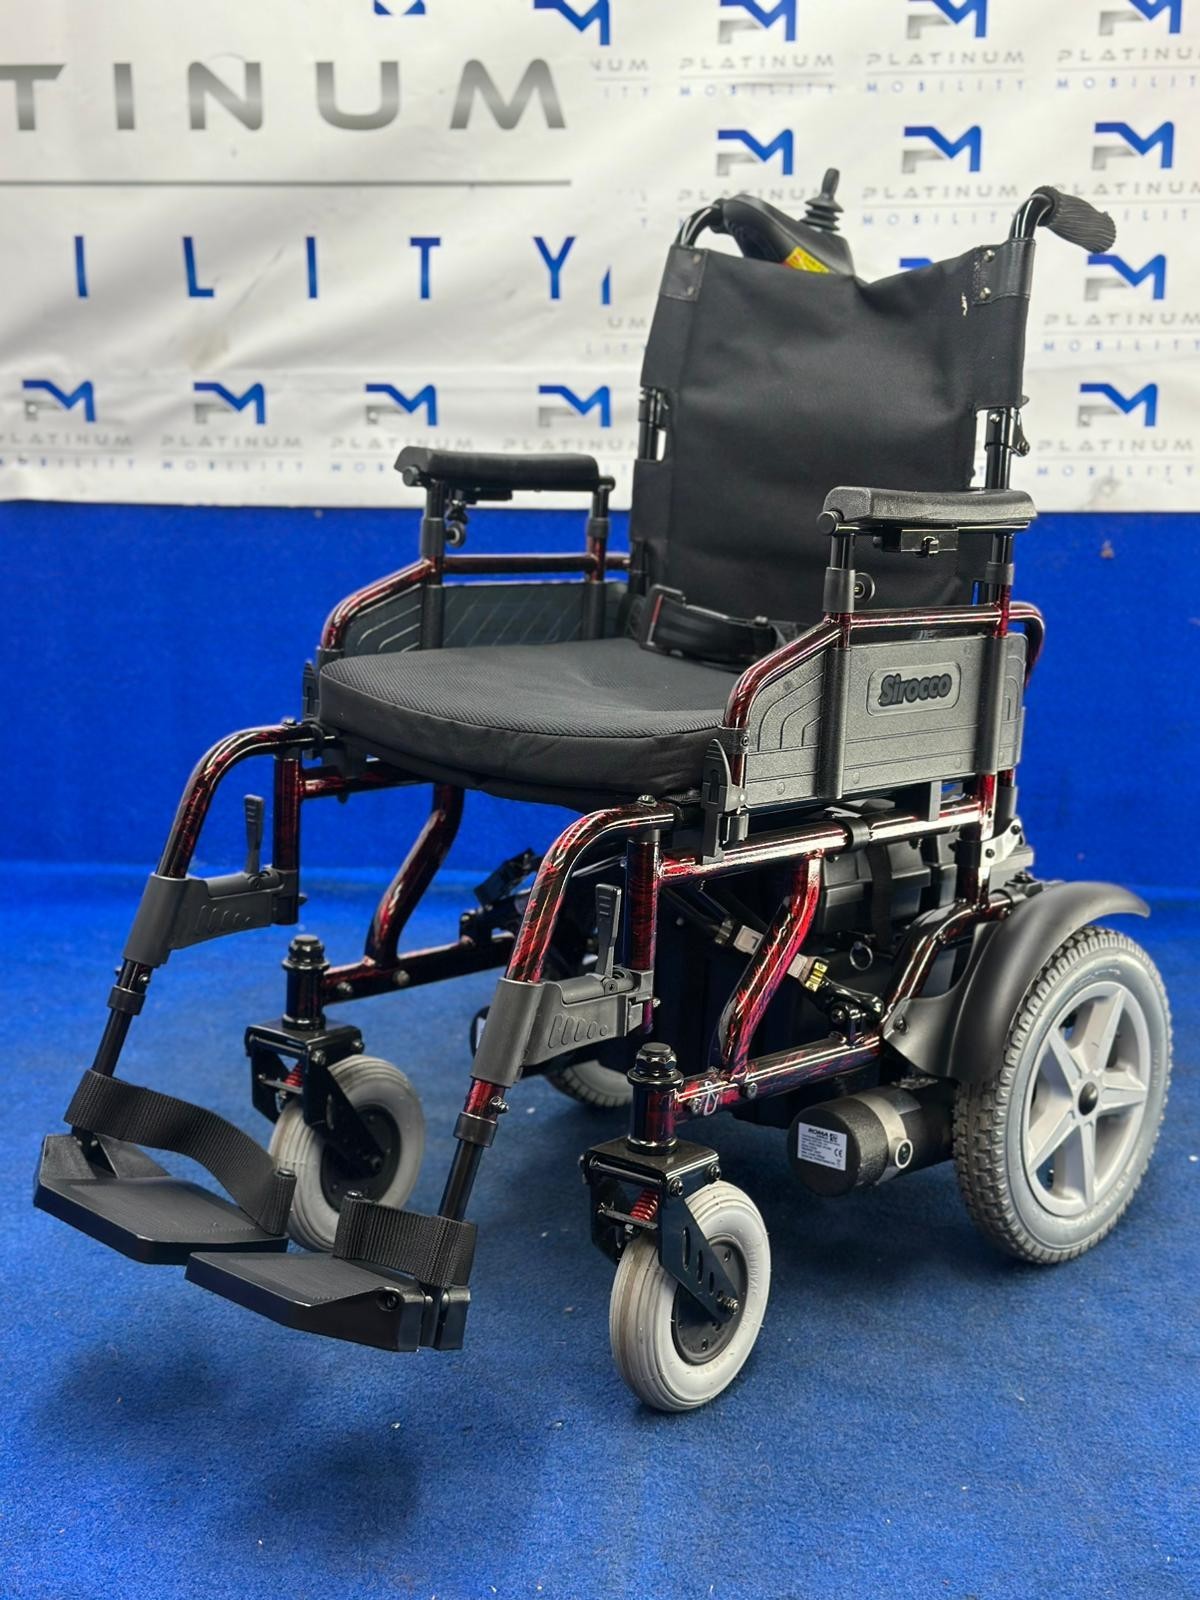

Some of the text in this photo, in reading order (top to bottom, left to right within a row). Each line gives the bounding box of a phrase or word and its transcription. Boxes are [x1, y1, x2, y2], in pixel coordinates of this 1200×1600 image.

[680, 54, 834, 69] PLATINUM
[867, 51, 1024, 66] PLATINUM
[1057, 48, 1200, 61] PLATINU
[680, 82, 834, 96] MOBILITY
[866, 79, 1024, 92] MOBILITY
[0, 58, 566, 131] TINUM
[862, 185, 1018, 199] PLATINUM
[74, 236, 576, 299] ILITY
[161, 435, 303, 447] PLATINUM
[1037, 440, 1193, 451] PLATINUM
[1037, 465, 1194, 477] MOBILITY
[878, 673, 953, 707] Sirocco
